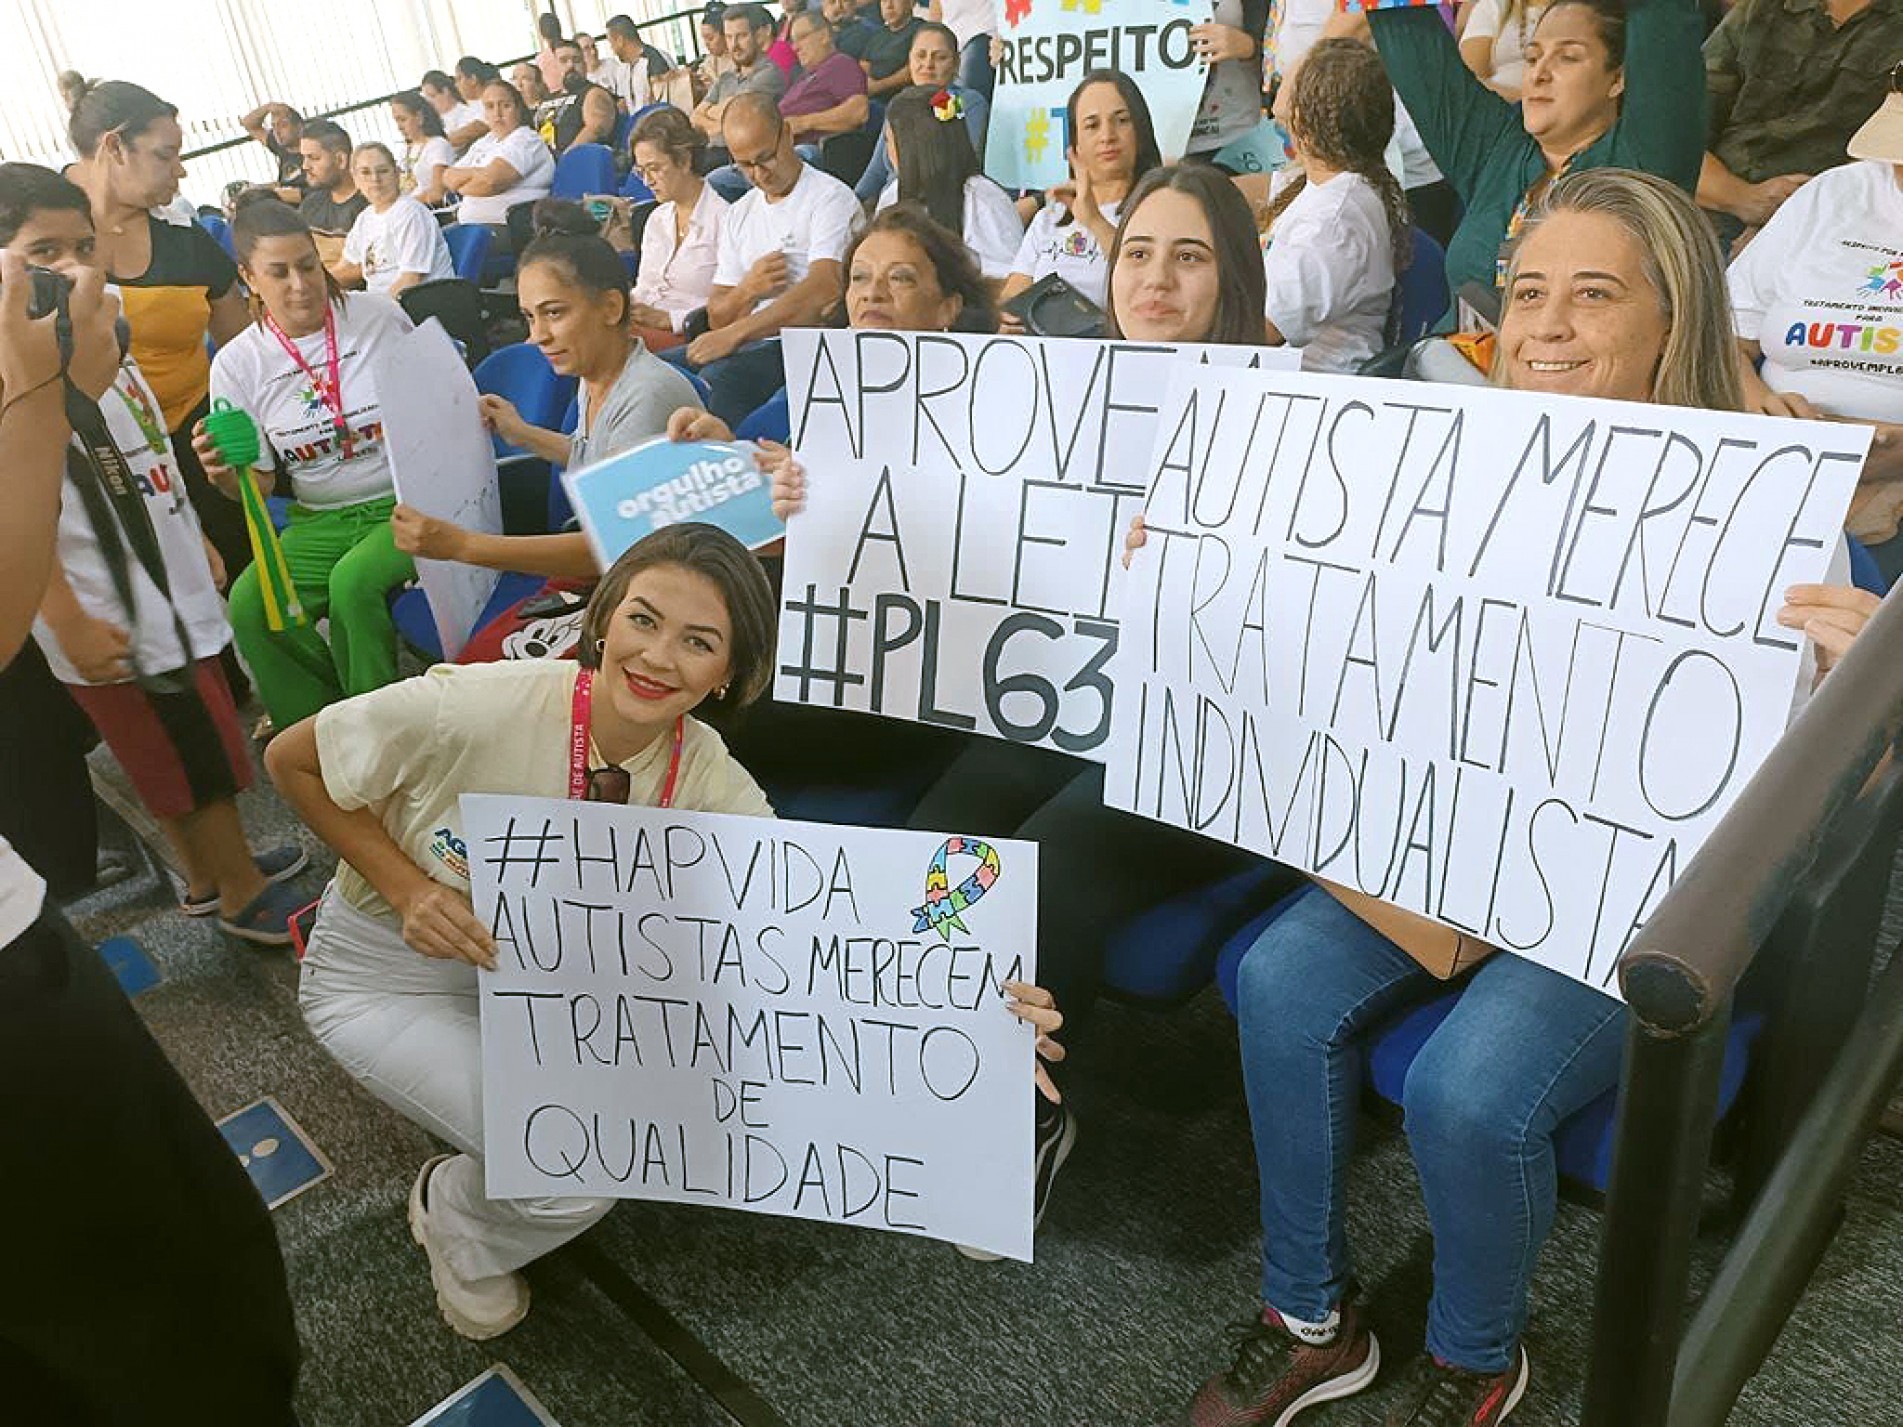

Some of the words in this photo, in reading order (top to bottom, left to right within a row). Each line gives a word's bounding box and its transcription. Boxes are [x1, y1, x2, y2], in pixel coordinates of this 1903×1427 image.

[795, 331, 1263, 481] APROVE
[94, 446, 129, 496] Nikon
[616, 456, 747, 519] orgulho
[1144, 387, 1465, 573] AUTISTA
[1468, 412, 1863, 652] MERECE
[847, 464, 911, 592] A
[949, 473, 1147, 626] LEI
[1143, 523, 1743, 820] TRATAMENTO
[572, 770, 584, 785] DE
[573, 723, 585, 769] AUTISTA
[484, 817, 862, 925] #HAPVIDA
[1134, 682, 1676, 988] INDIVIDUALISTA
[492, 891, 790, 996] AUTISTAS
[807, 933, 1023, 1025] MERECEM
[493, 991, 981, 1101] TRATAMENTO
[712, 1078, 770, 1129] DE
[524, 1104, 928, 1231] QUALIDADE
